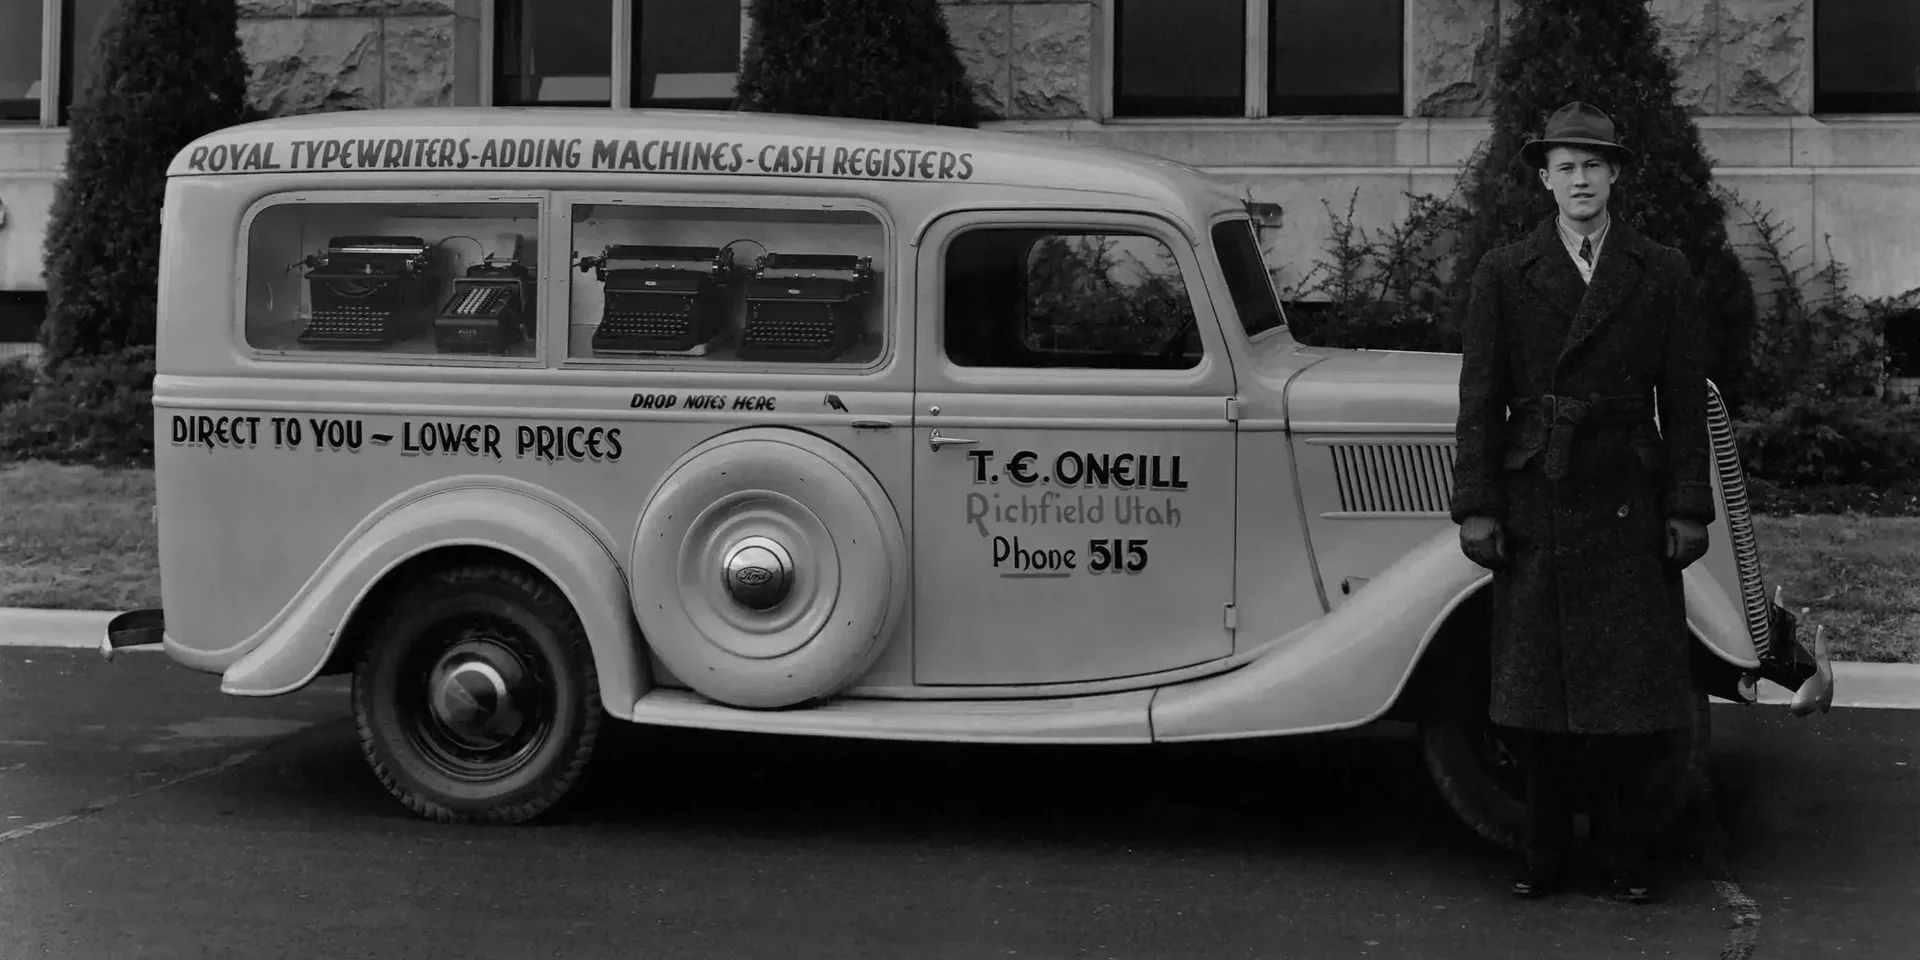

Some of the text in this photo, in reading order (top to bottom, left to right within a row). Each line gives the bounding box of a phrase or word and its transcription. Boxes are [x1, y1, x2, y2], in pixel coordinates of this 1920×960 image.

[188, 142, 281, 172] ROYAL
[832, 146, 974, 181] REGISTERS
[630, 393, 776, 412] DROP NOTES HERE
[171, 415, 261, 450] DIRECT
[271, 416, 301, 447] TO
[310, 418, 364, 450] YOU
[403, 421, 502, 460] LOWER
[517, 424, 623, 462] PRICES
[966, 491, 1182, 538] Richfield Utah
[993, 535, 1149, 574] Phone 515
[739, 569, 768, 581] Ford
